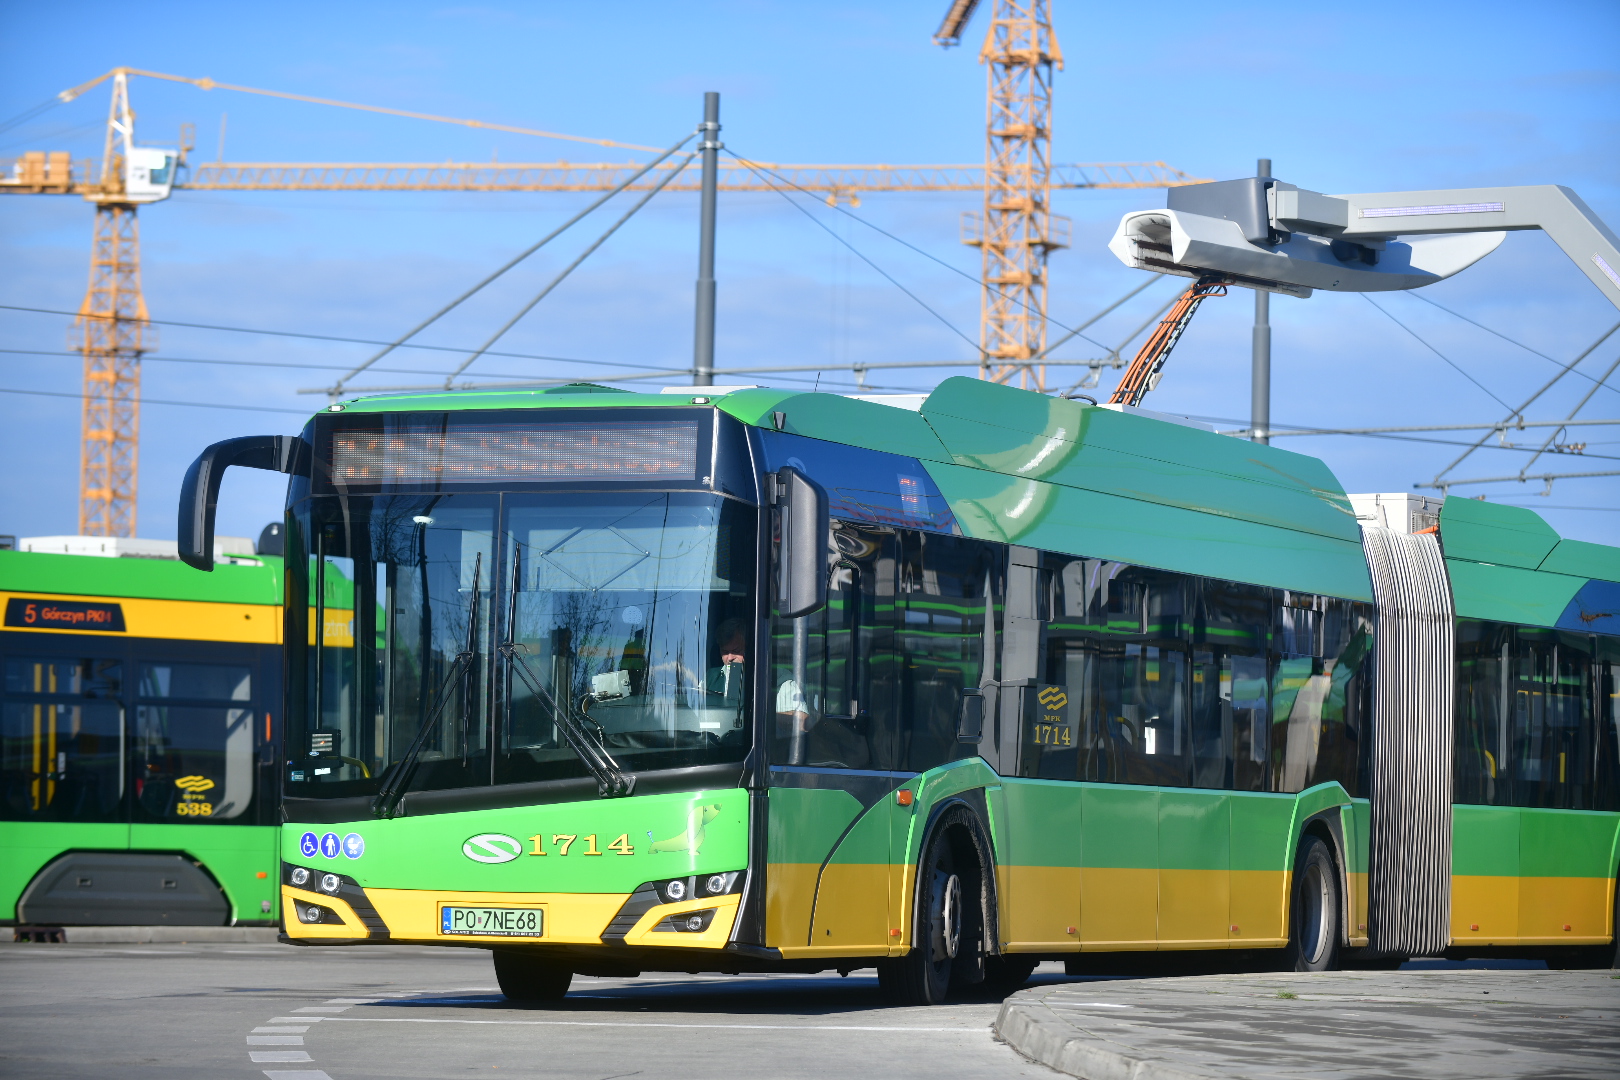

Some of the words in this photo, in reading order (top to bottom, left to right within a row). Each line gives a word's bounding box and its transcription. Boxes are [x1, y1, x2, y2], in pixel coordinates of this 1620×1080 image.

[24, 604, 37, 623] 5
[41, 607, 85, 624] Górczyn
[1034, 724, 1071, 745] 1714
[176, 802, 213, 816] 538
[528, 833, 635, 856] 1714
